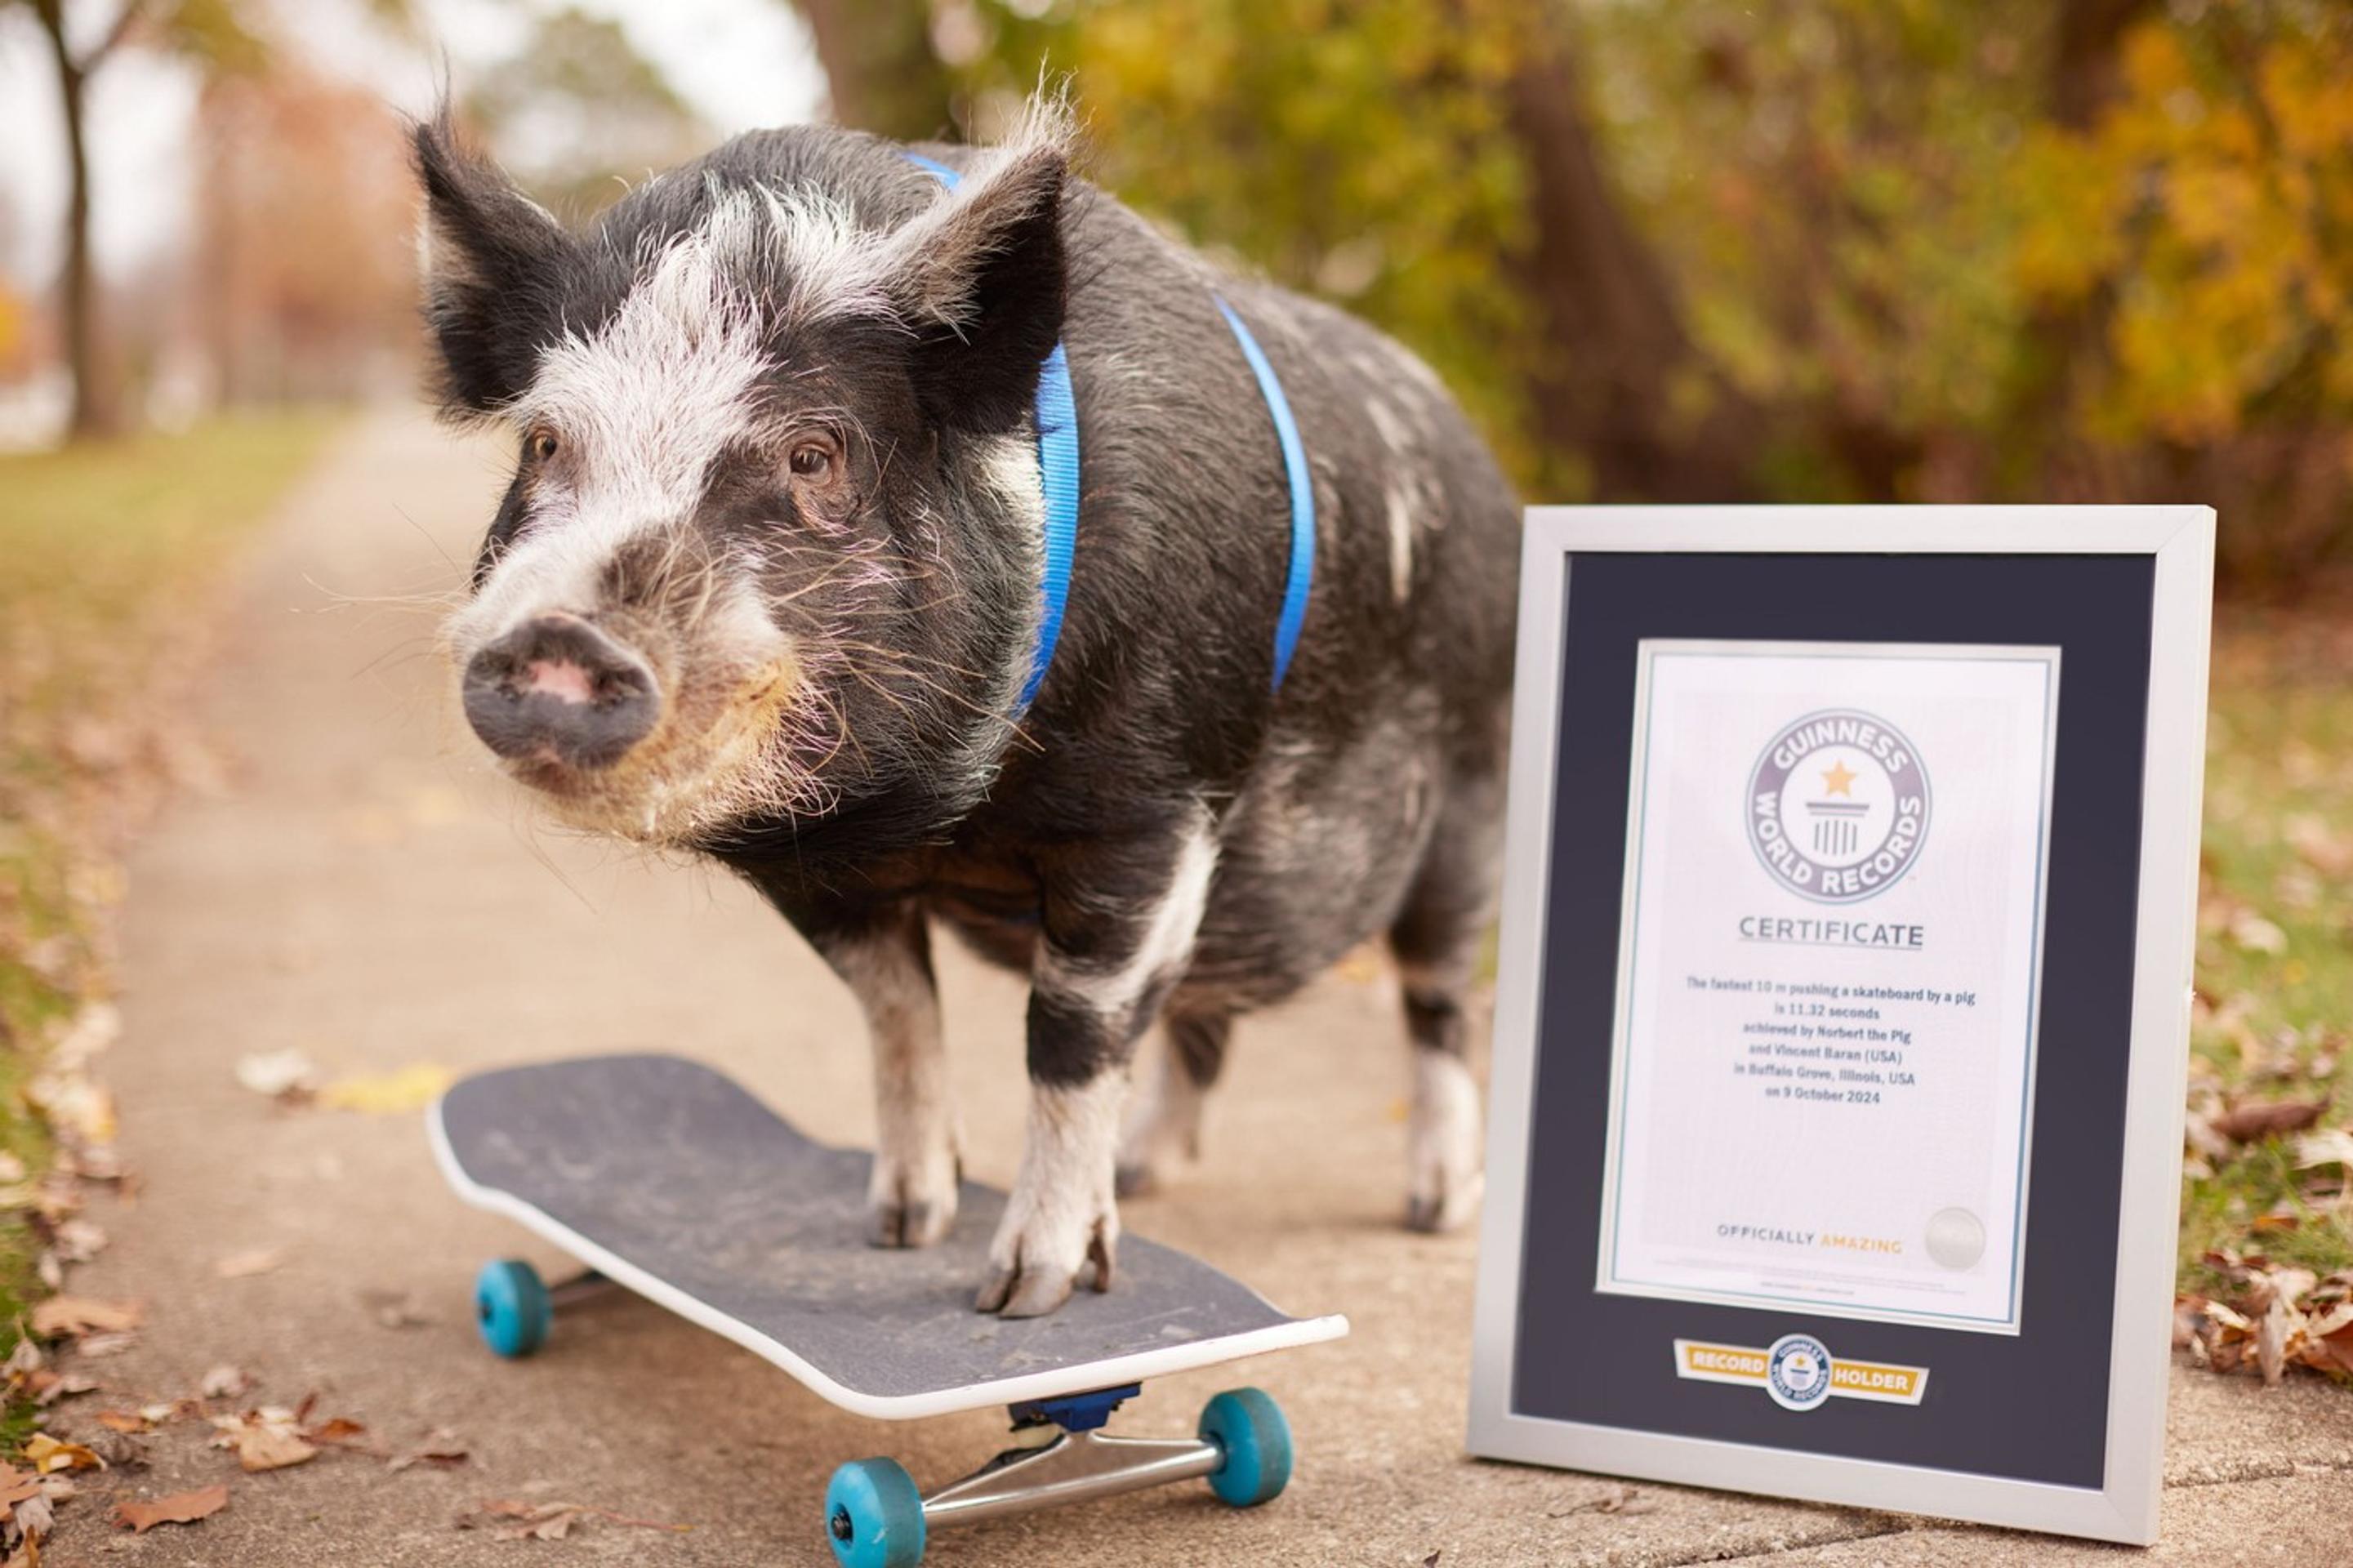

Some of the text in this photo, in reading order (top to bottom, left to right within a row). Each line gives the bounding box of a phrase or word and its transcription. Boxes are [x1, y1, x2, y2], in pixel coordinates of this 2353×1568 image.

[1773, 719, 1909, 773] GUINNESS
[1755, 791, 1920, 894] WORLD RECORDS
[1739, 916, 1924, 947] CERTIFICATE
[1687, 976, 1976, 1006] The fastest 10 m pushing a skateboard by a pig
[1775, 1003, 1880, 1020] is 11.32 seconds
[1743, 1022, 1911, 1045] achieved by Norbert the Pig
[1749, 1044, 1903, 1065] and Vincent Baran (USA)
[1733, 1062, 1916, 1085] in Buffalo Grove, Illinois, USA
[1765, 1086, 1880, 1103] on 9 October 2024
[1718, 1223, 1903, 1254] OFFICIALLY AMAZING
[1692, 1351, 1909, 1391] RECORD HOLDER
